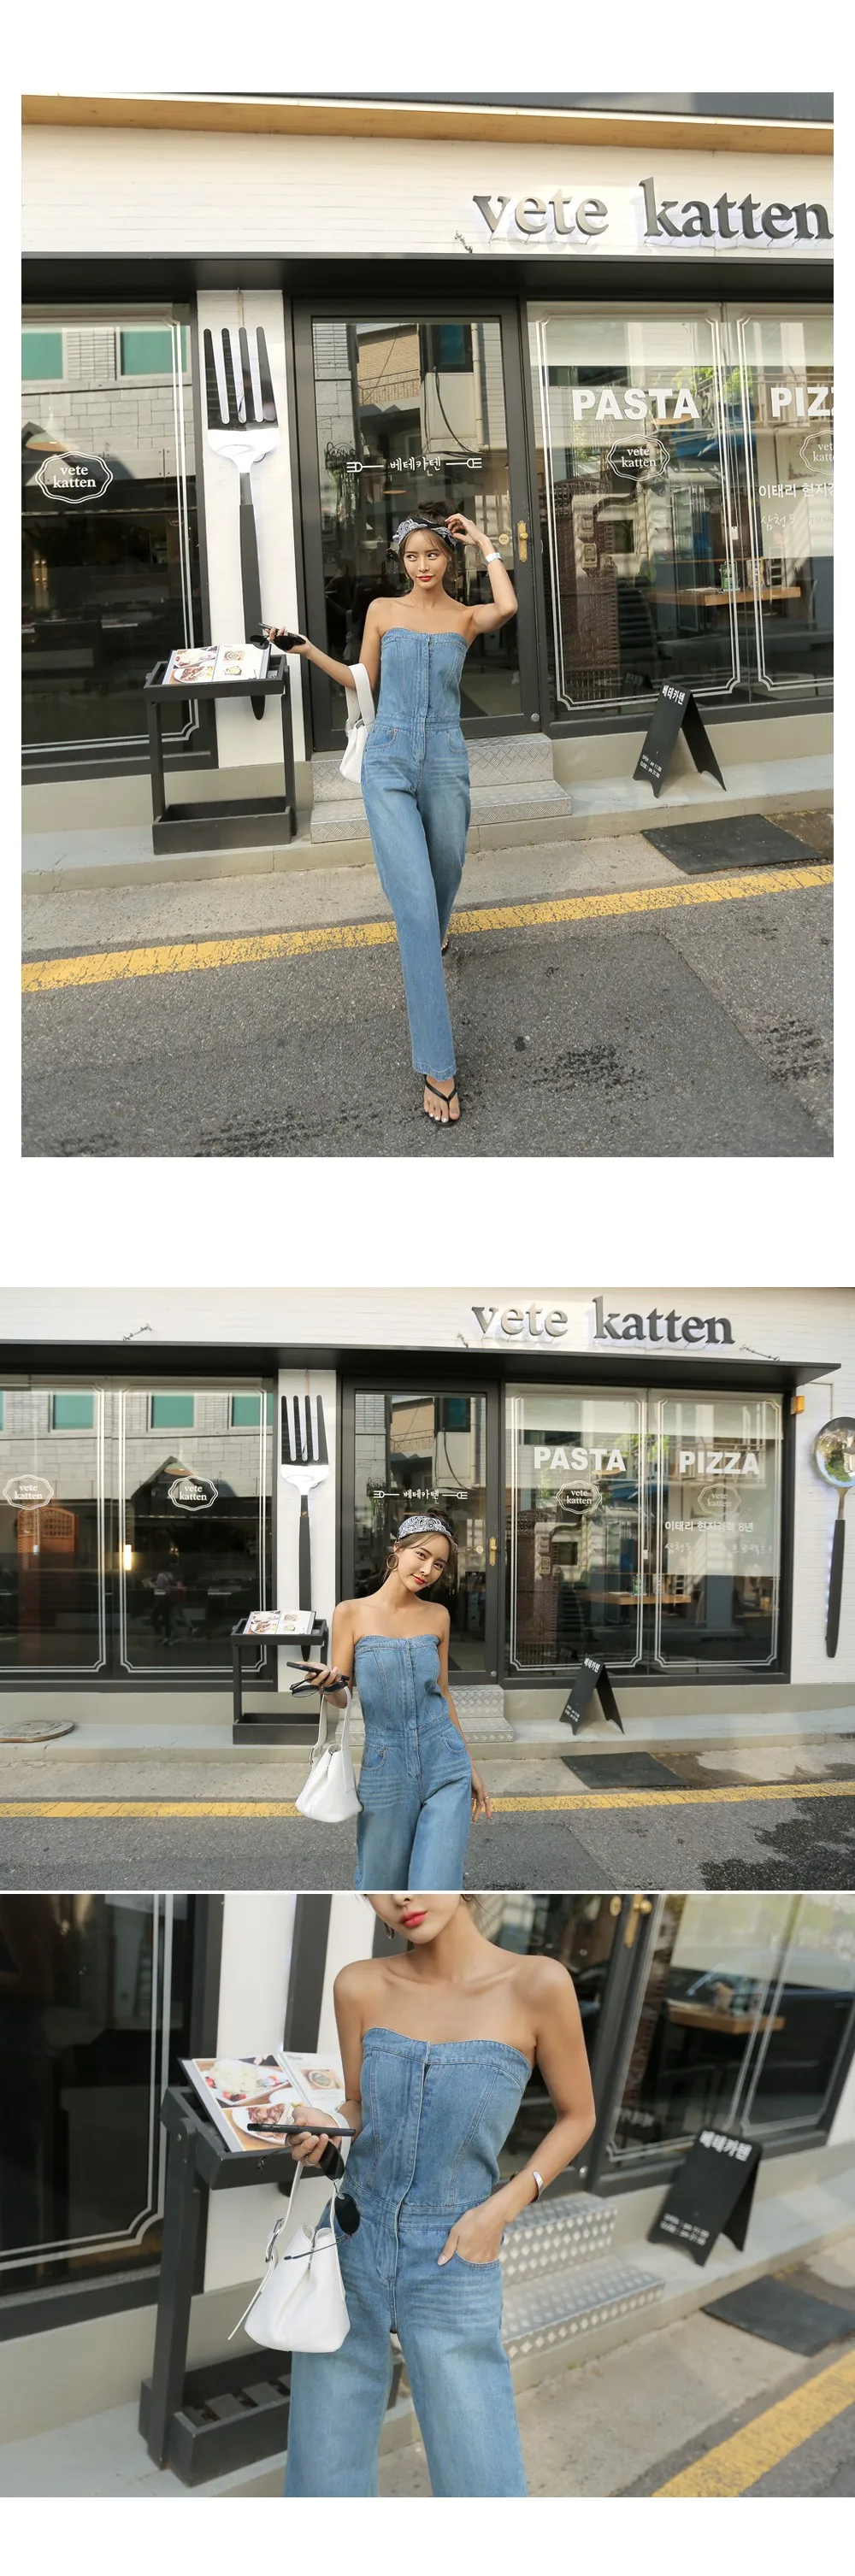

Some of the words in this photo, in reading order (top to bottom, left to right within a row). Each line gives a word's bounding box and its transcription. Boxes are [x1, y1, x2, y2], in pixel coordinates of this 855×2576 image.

[473, 188, 609, 236] vete
[639, 177, 834, 239] katten
[572, 388, 700, 421] PASTA
[770, 387, 834, 417] PIZ
[627, 447, 650, 457] vete
[817, 443, 834, 451] vet
[622, 456, 657, 468] katten
[61, 465, 89, 475] vete
[53, 475, 97, 488] katten
[758, 483, 796, 498] 이태리
[662, 685, 686, 705] 베테카텐
[472, 1302, 568, 1337] vete
[593, 1296, 735, 1344] katten
[534, 1447, 626, 1471] PASTA
[680, 1451, 759, 1474] PIZZA
[14, 1491, 43, 1500] katten
[180, 1491, 207, 1501] katten
[566, 1496, 592, 1505] katten
[664, 1521, 693, 1532] 이태리
[738, 1522, 754, 1532] 8년
